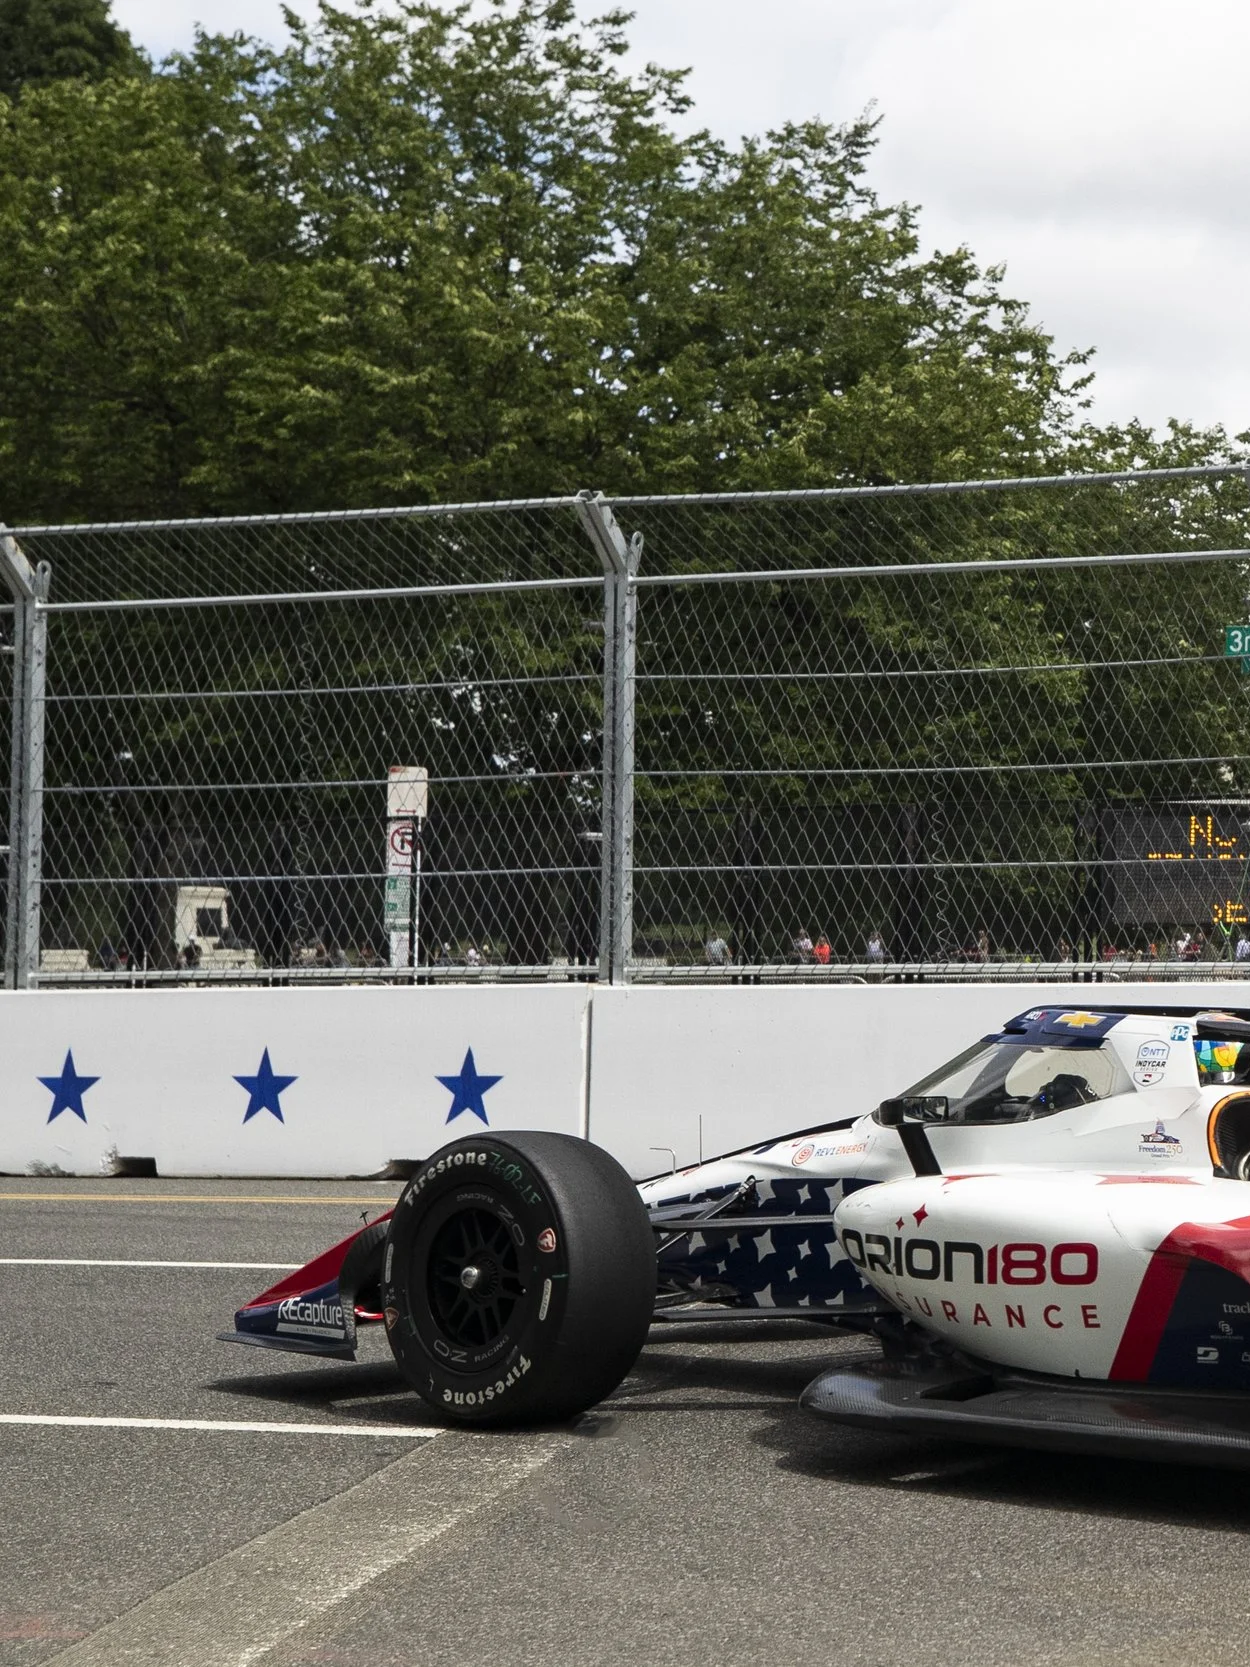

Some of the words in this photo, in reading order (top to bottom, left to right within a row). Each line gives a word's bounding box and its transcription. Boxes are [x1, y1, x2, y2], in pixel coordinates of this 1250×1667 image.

[1135, 1060, 1167, 1068] INDYCAR
[1150, 1048, 1167, 1056] NTT
[404, 1151, 487, 1206] Firestone
[277, 1296, 344, 1325] REcapture
[443, 1353, 532, 1405] Firestone
